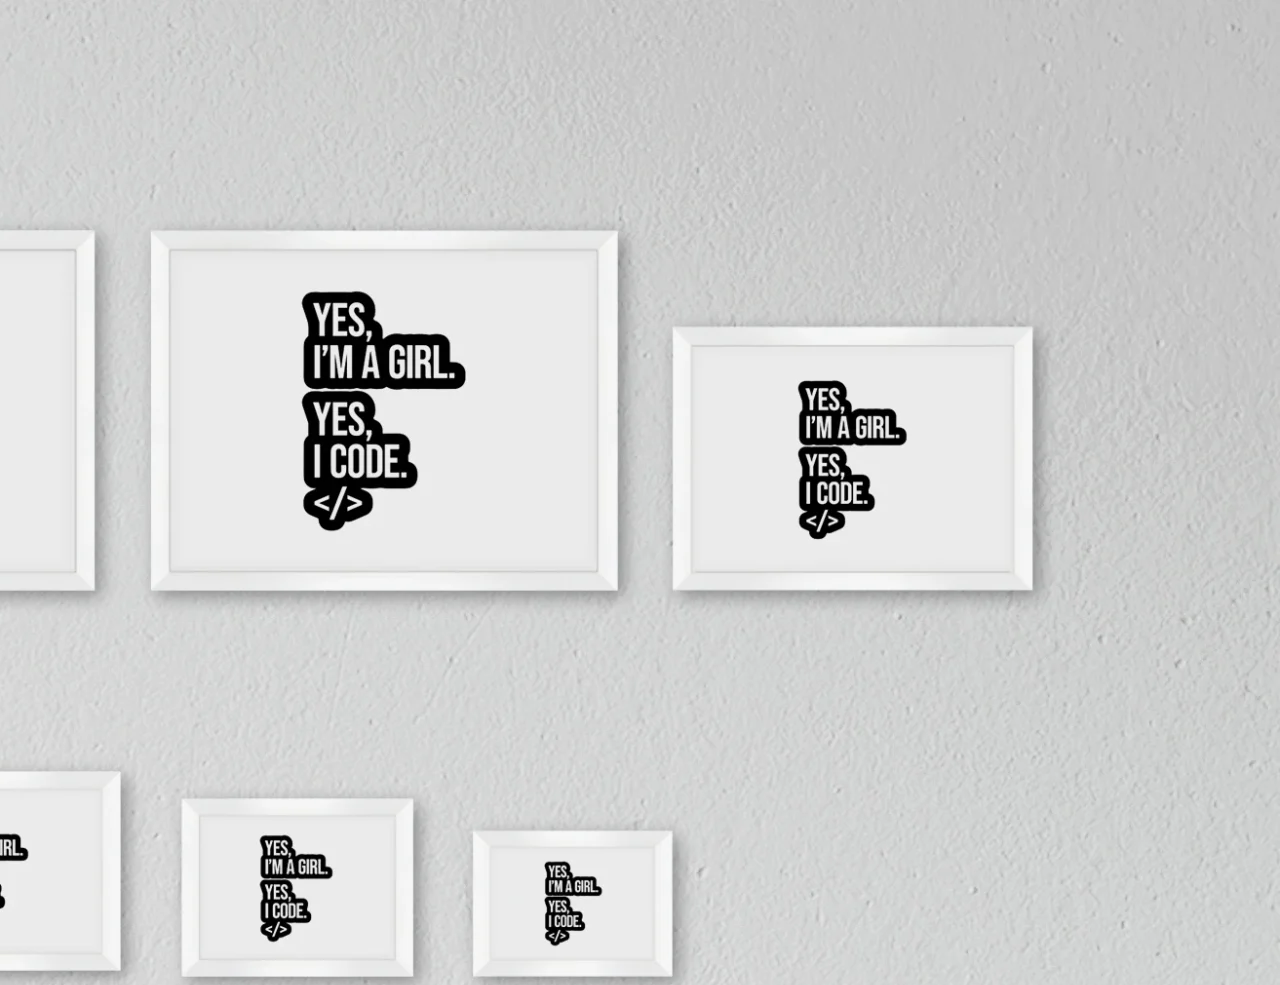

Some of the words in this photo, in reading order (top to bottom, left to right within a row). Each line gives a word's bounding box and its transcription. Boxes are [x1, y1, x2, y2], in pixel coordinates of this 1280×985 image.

[313, 302, 372, 341] YES,
[314, 344, 352, 378] I'M
[361, 344, 379, 378] A
[388, 344, 455, 379] GIRL.
[805, 388, 845, 414] YES,
[313, 401, 372, 441] YES,
[806, 416, 831, 439] I'M
[838, 416, 850, 439] A
[856, 416, 900, 439] GIRL.
[313, 443, 321, 479] I
[330, 444, 406, 479] CODE.
[805, 454, 845, 480] YES,
[805, 481, 811, 505] I
[817, 481, 868, 504] CODE.
[265, 840, 291, 857] YES,
[265, 859, 282, 874] I'M
[286, 859, 294, 874] A
[298, 859, 327, 874] GIRL.
[549, 866, 569, 879] YES,
[265, 884, 291, 902] YES,
[549, 880, 562, 893] I'M
[566, 880, 572, 893] A
[575, 880, 598, 893] GIRL.
[265, 903, 268, 919] I
[272, 903, 306, 919] CODE.
[549, 901, 569, 914] YES,
[555, 915, 582, 928] CODE.
